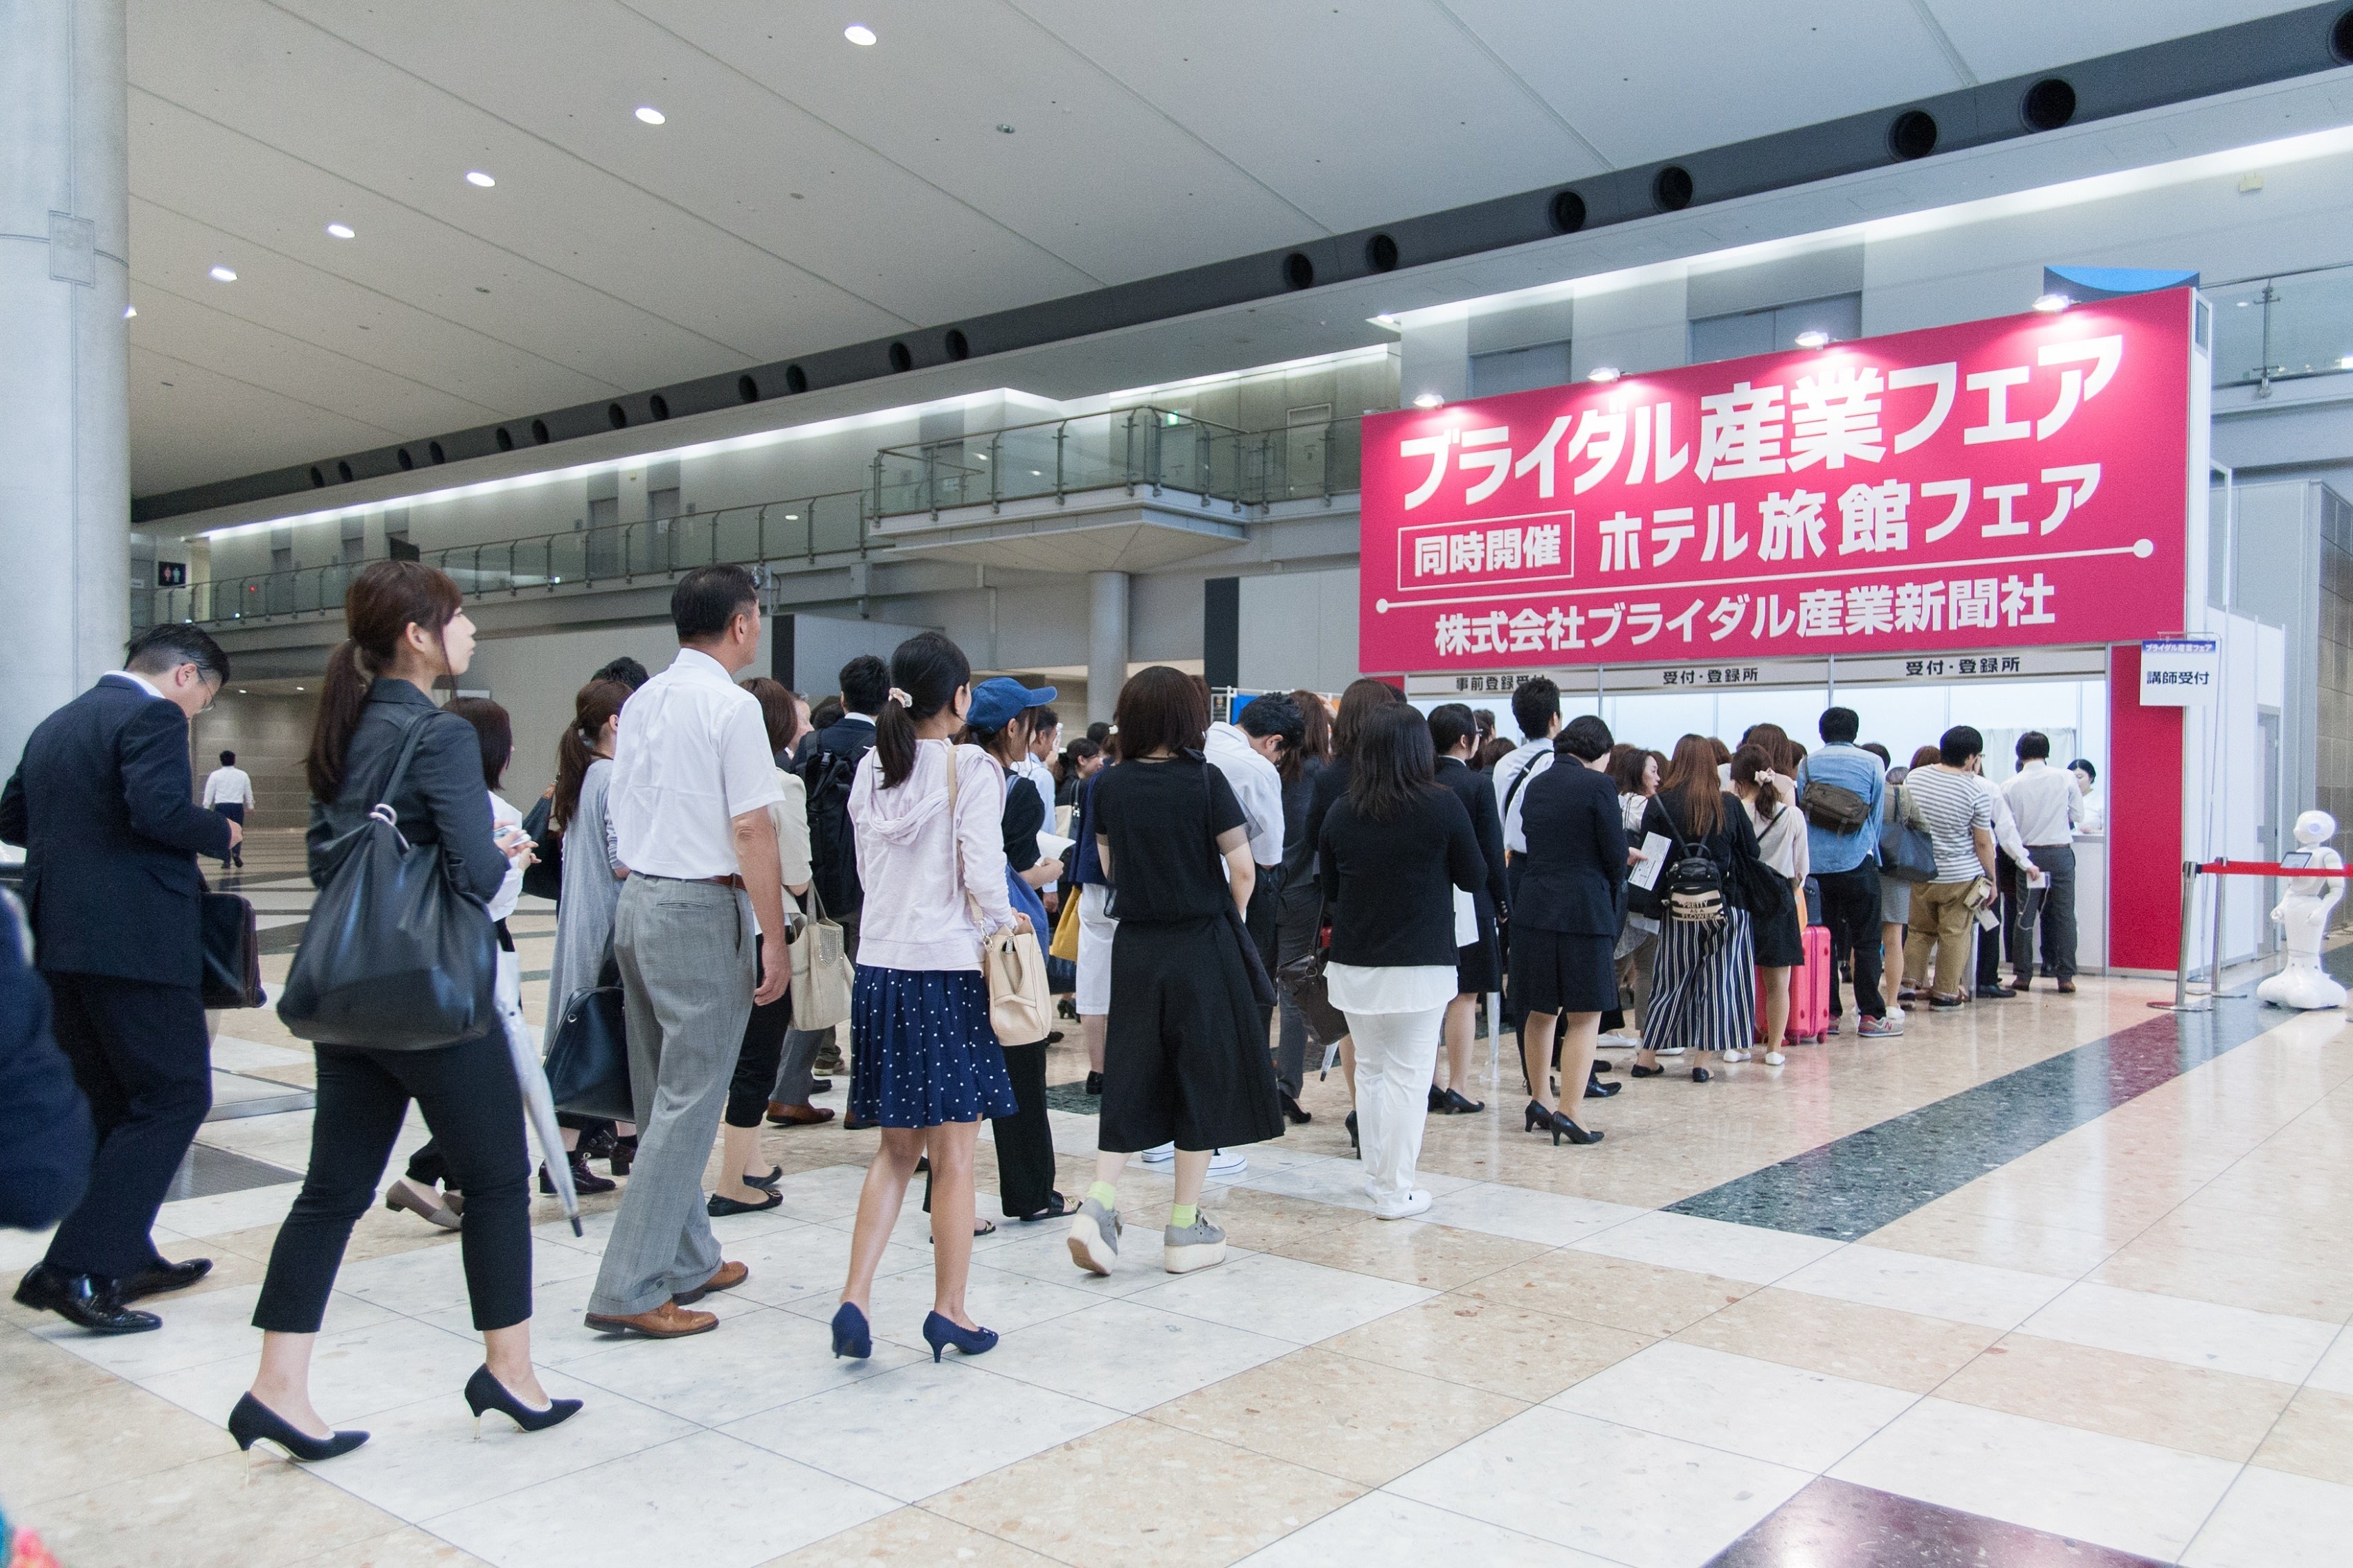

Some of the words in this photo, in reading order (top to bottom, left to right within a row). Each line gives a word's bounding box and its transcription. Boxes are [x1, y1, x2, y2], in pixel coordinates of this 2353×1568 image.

[1400, 334, 2123, 511] ブライダル産業フェア
[1415, 524, 1561, 577] 同時開催
[1599, 463, 2101, 572] ホテル旅館フェア
[1435, 573, 2055, 656] 株式会社ブライダル産業新聞社
[1456, 675, 1545, 691] 事前登録受
[2147, 671, 2210, 684] 講師受付
